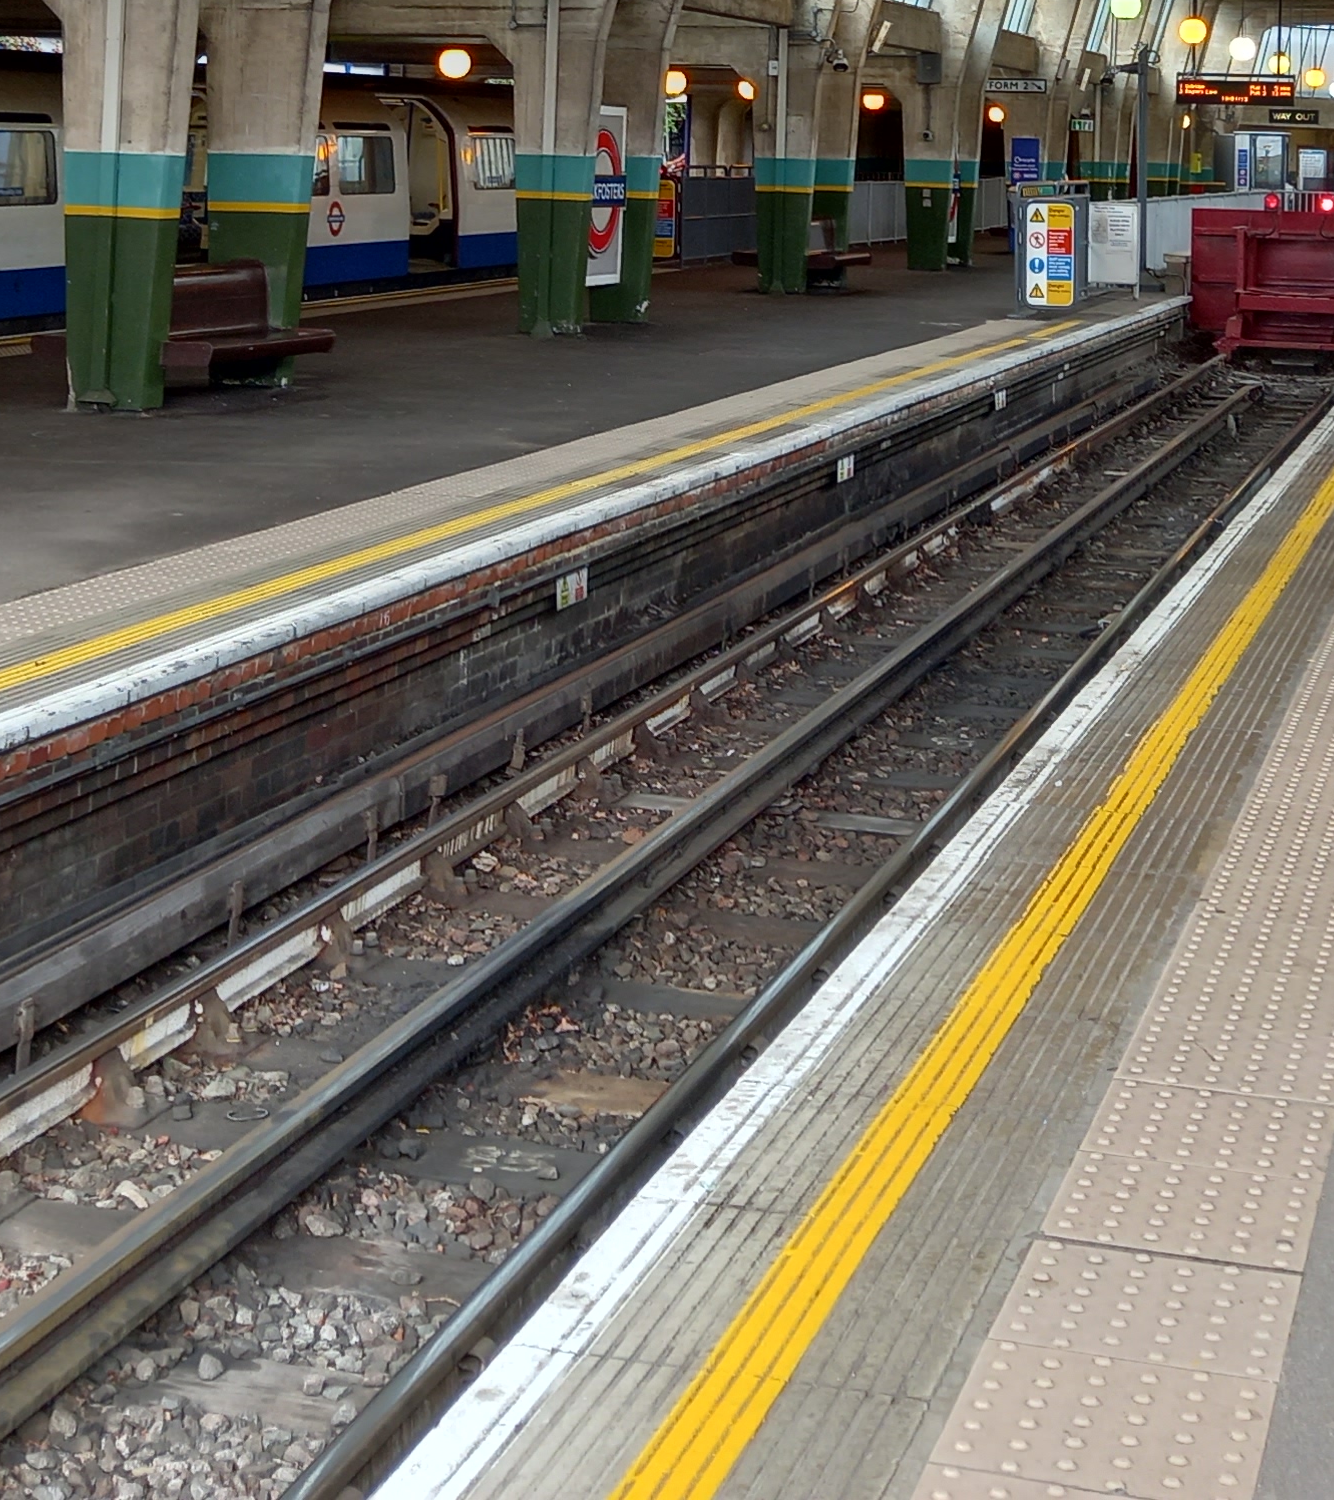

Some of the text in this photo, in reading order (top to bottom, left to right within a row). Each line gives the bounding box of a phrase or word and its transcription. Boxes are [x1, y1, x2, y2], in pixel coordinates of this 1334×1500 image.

[988, 81, 1029, 90] FORM 2
[1271, 112, 1316, 121] WAY OUT
[593, 183, 625, 200] KFOSTERS
